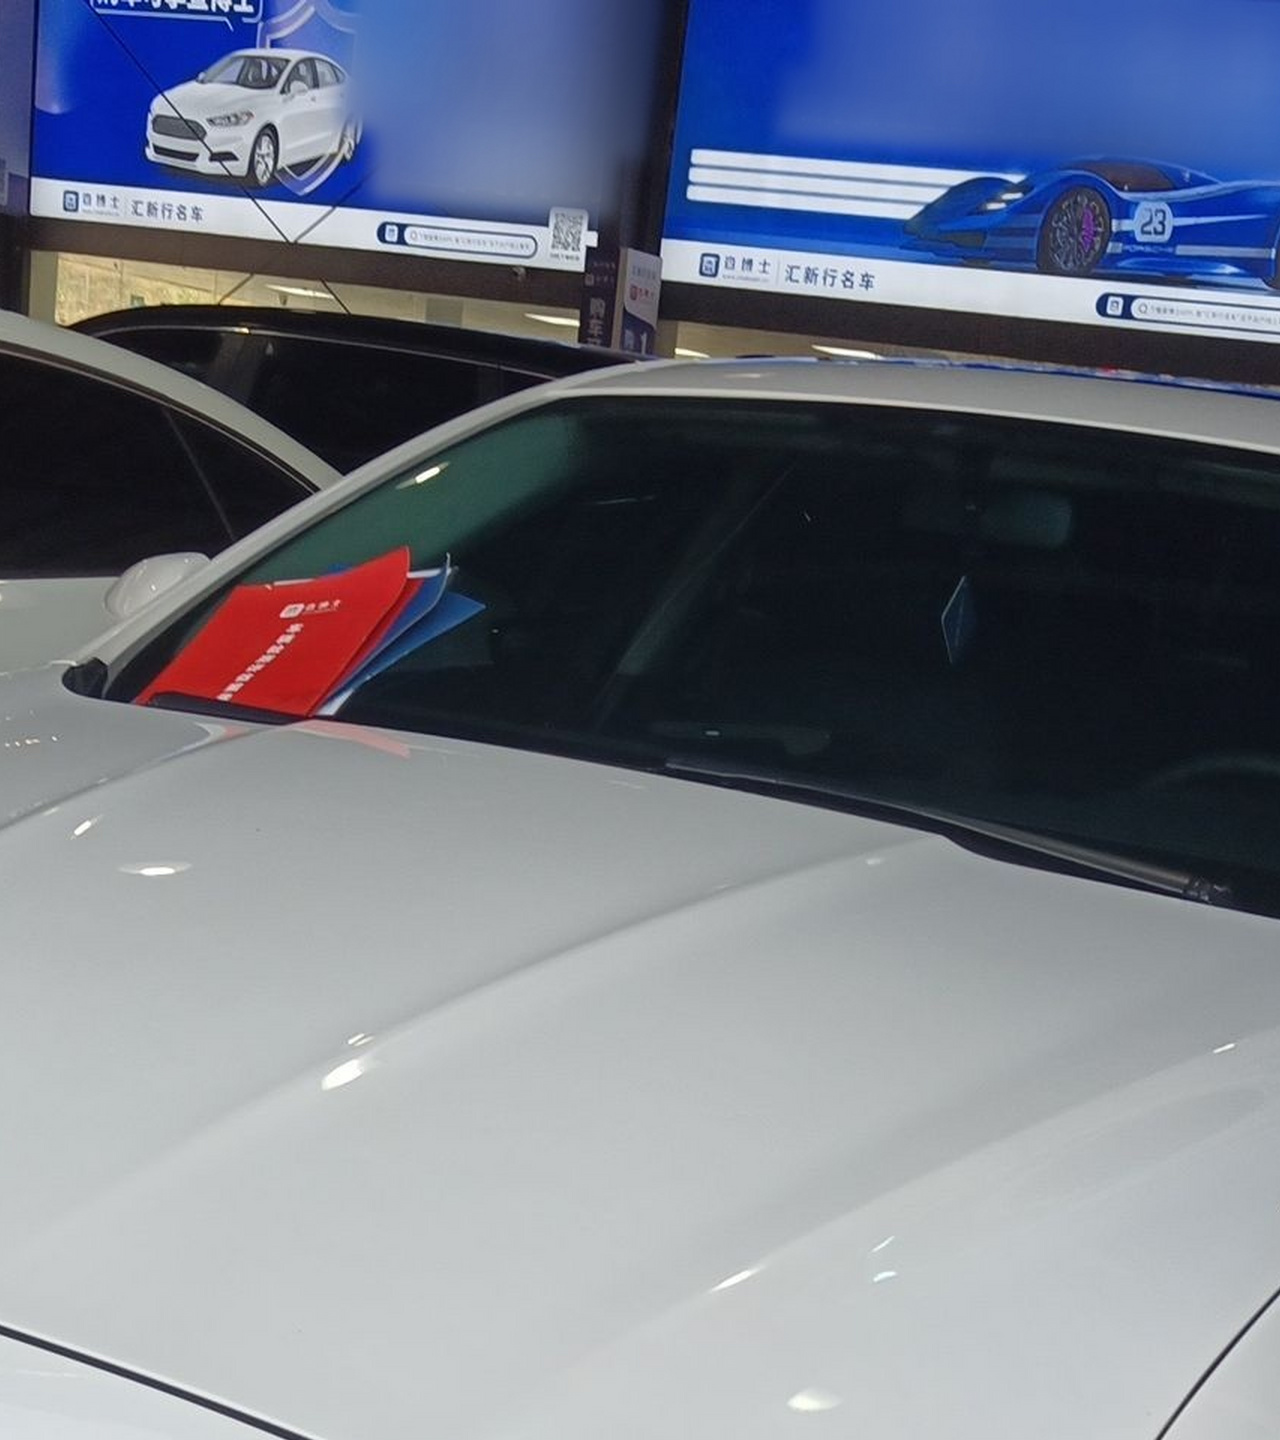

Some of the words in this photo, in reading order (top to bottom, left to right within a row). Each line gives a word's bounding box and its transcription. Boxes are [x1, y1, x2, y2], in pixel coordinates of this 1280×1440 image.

[131, 199, 204, 222] 汇新行名车
[1140, 207, 1166, 236] 23
[785, 264, 875, 291] 汇新行名车
